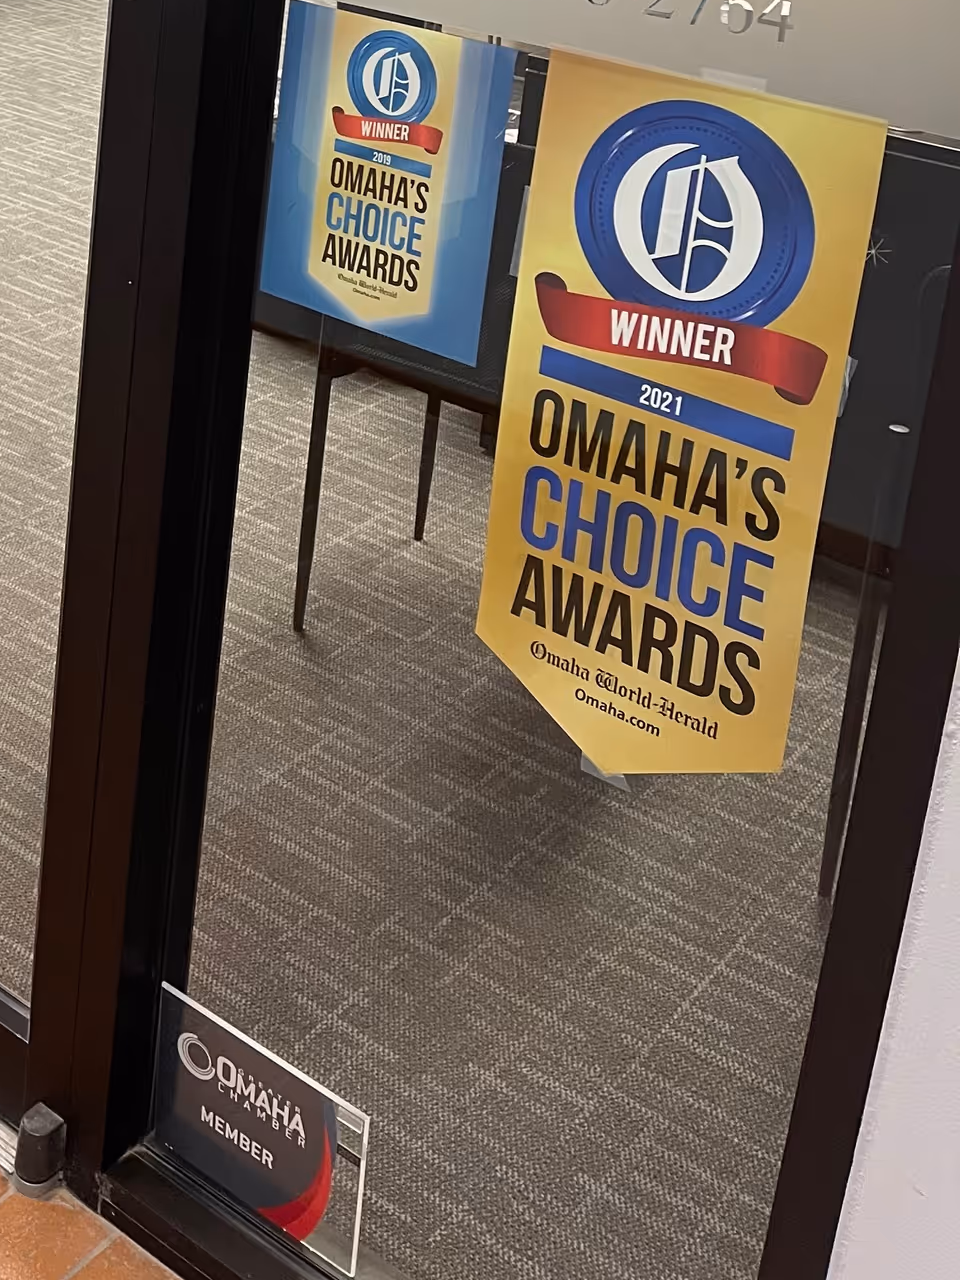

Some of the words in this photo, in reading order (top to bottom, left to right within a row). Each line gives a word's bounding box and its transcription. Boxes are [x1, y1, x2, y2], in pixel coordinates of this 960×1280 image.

[360, 120, 410, 142] WINNER
[372, 151, 392, 166] 2019
[330, 157, 430, 214] OMAHA'S
[325, 192, 426, 257] CHOICE
[321, 233, 421, 292] AWARDS
[610, 308, 736, 365] WINNER
[639, 384, 683, 416] 2021
[529, 389, 787, 542] OMAHA'S
[520, 465, 776, 642] CHOICE
[510, 554, 762, 716] AWARDS
[530, 640, 590, 682] Omaha
[595, 668, 720, 740] World-Herald
[574, 687, 661, 737] Omaha.com
[217, 1056, 305, 1139] OMAHA
[218, 1081, 306, 1149] CHAMBER
[201, 1105, 274, 1169] MEMBER
